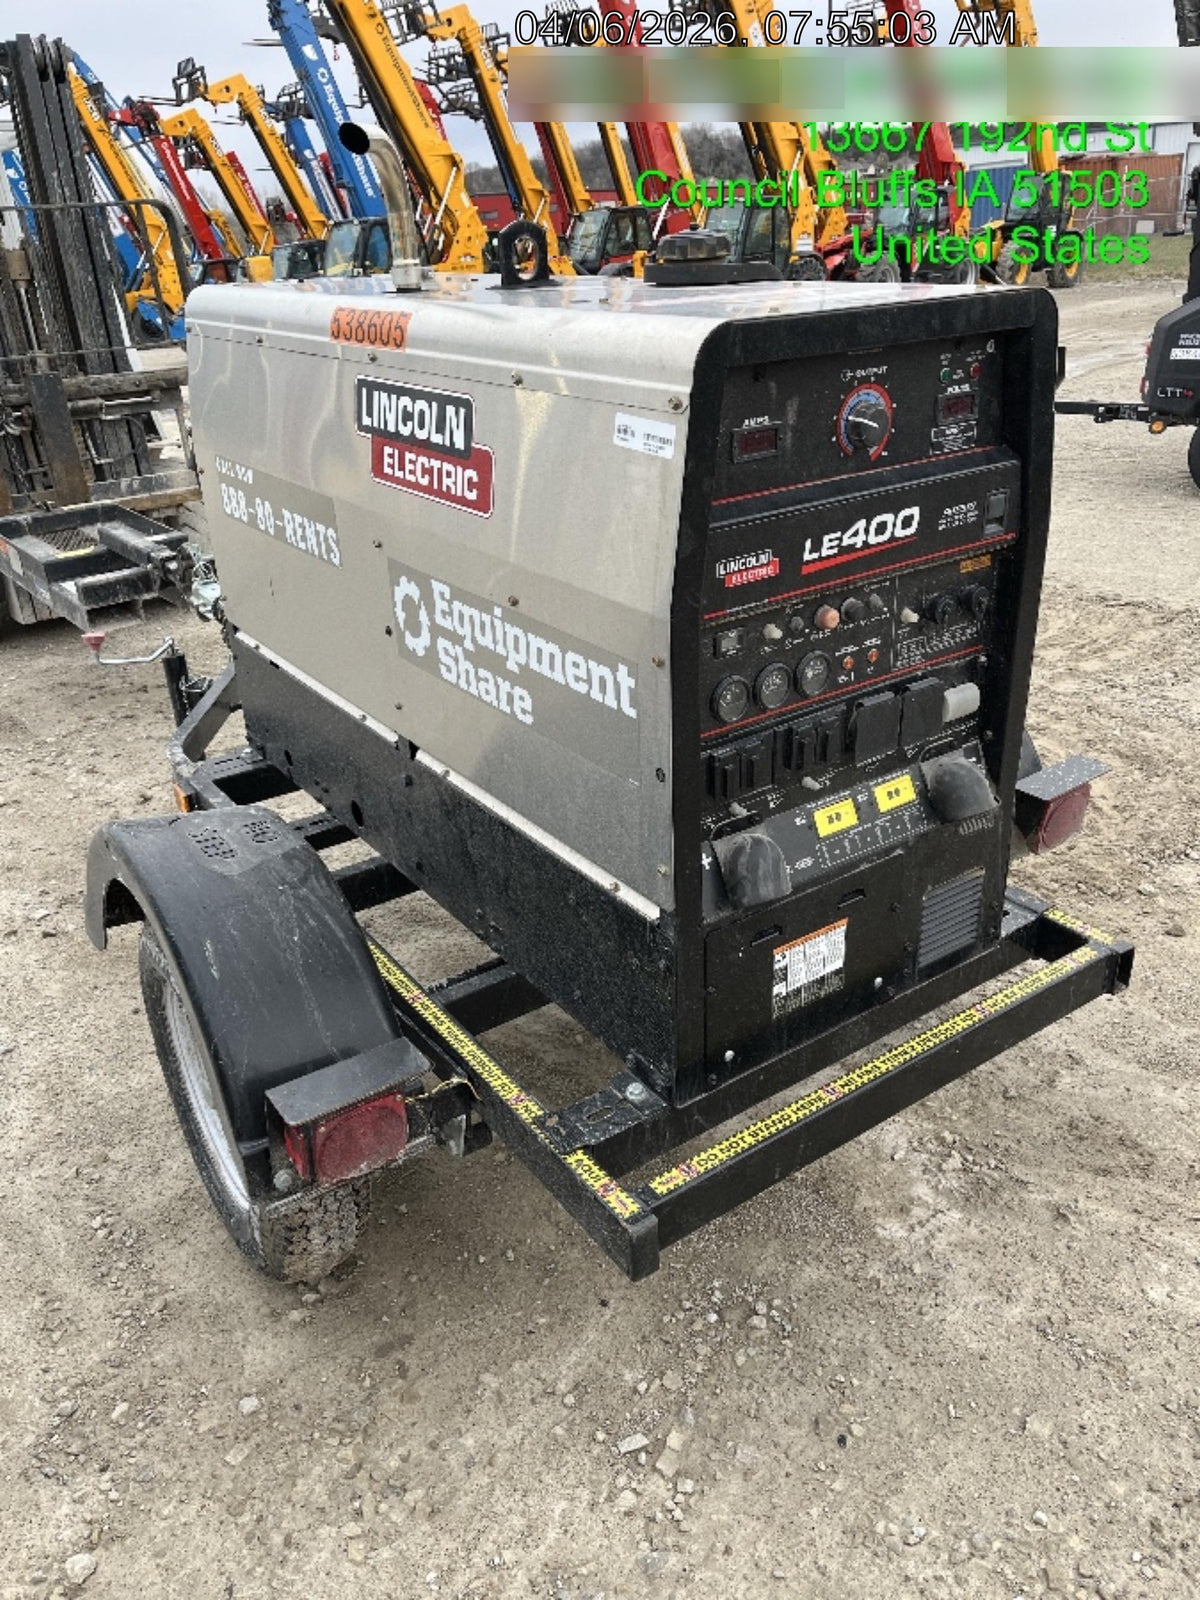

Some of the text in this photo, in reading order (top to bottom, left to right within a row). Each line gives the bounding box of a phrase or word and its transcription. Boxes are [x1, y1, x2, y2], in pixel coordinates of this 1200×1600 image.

[331, 307, 410, 348] 538605
[362, 387, 467, 450] LINCOLN
[383, 446, 479, 500] ELECTRIC
[221, 482, 340, 566] 888-80-RENTS
[803, 506, 920, 563] LE400
[719, 552, 770, 575] LINCOLN
[731, 565, 774, 585] ELECTRIC
[430, 579, 638, 719] Equipment
[436, 636, 534, 725] Share
[465, 1047, 501, 1081] DEBOUT
[695, 1091, 826, 1169] DO NOT STAND HERE
[572, 1156, 603, 1184] AQUI
